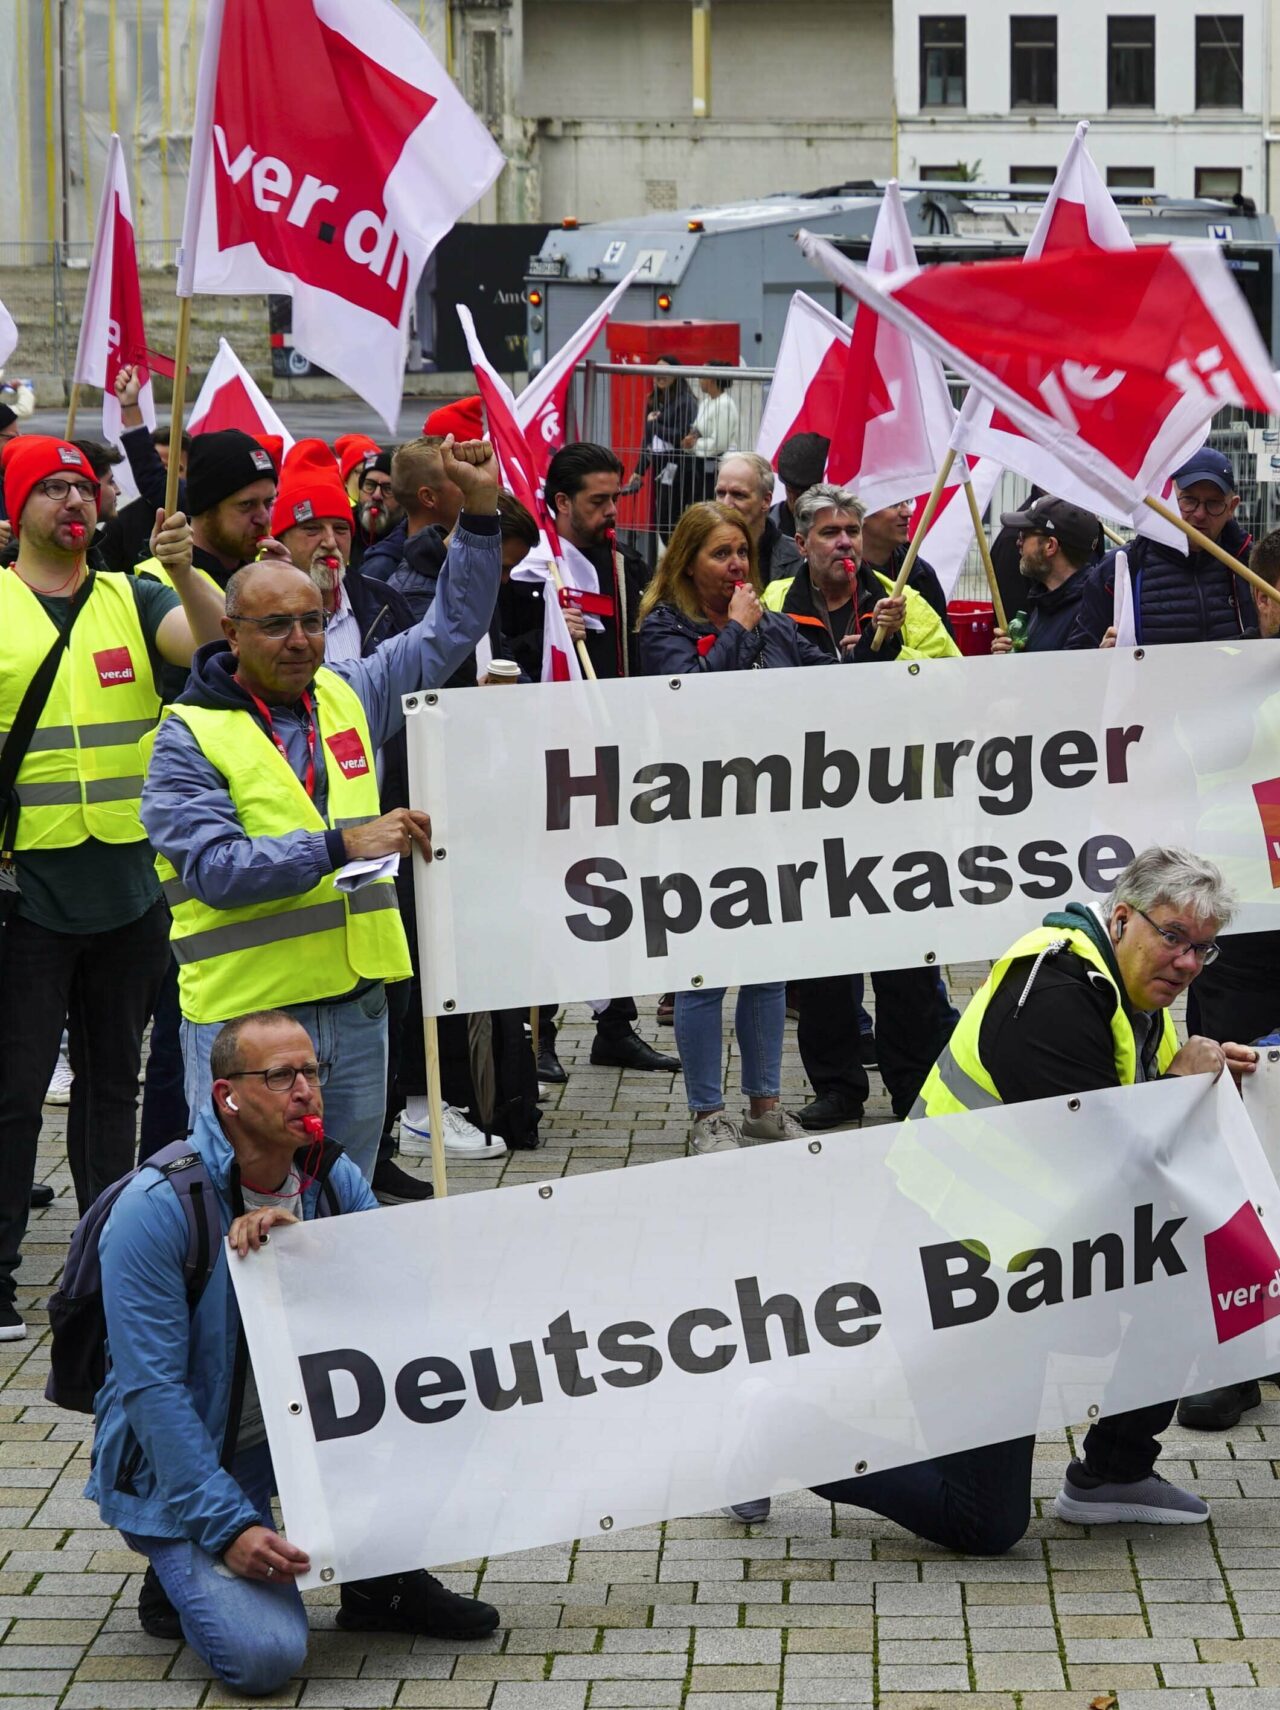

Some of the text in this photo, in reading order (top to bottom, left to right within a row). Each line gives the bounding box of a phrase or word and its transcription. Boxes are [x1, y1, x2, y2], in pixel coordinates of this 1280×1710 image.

[638, 256, 653, 273] A
[100, 667, 133, 680] ver.di
[340, 755, 367, 770] ver.di
[546, 724, 1144, 831] Hamburger
[564, 834, 1131, 959] Sparkasse
[298, 1203, 1188, 1442] Deutsche Bank
